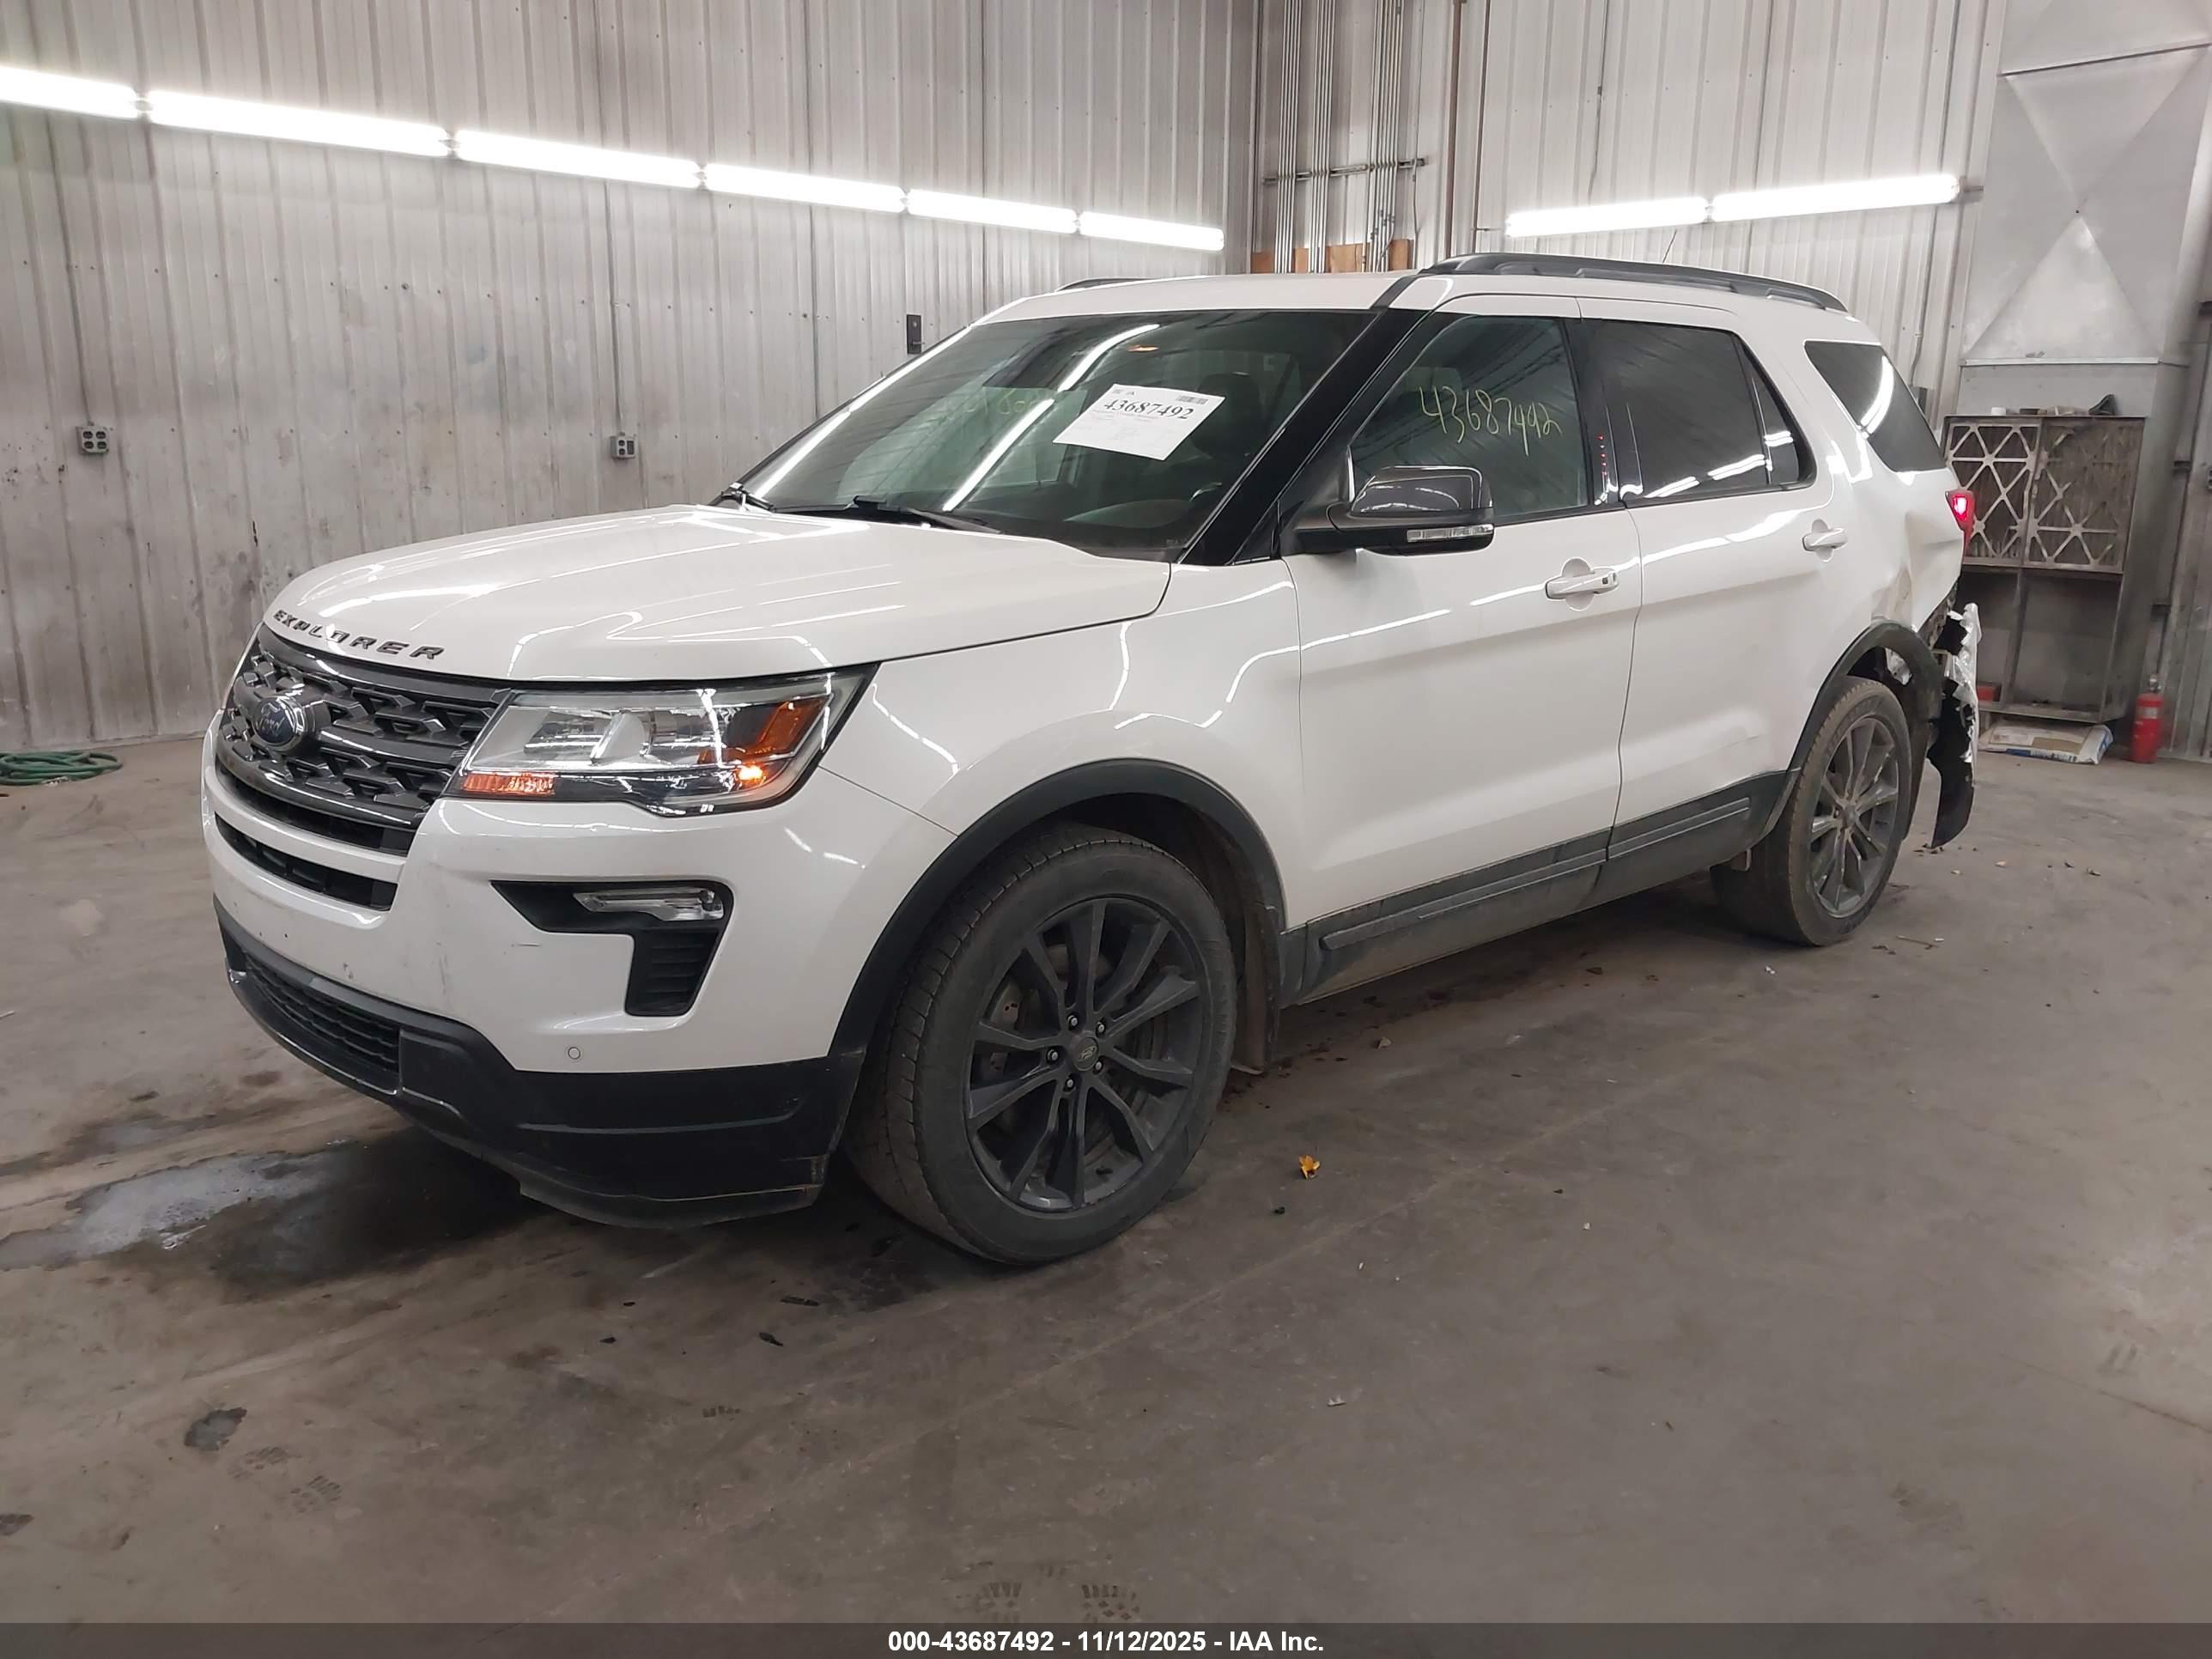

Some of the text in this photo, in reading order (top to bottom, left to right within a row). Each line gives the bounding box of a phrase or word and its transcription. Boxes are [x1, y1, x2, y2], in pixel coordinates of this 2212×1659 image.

[1103, 398, 1196, 420] 43687492
[1419, 386, 1563, 457] 43687492
[272, 609, 445, 660] EXPLORER
